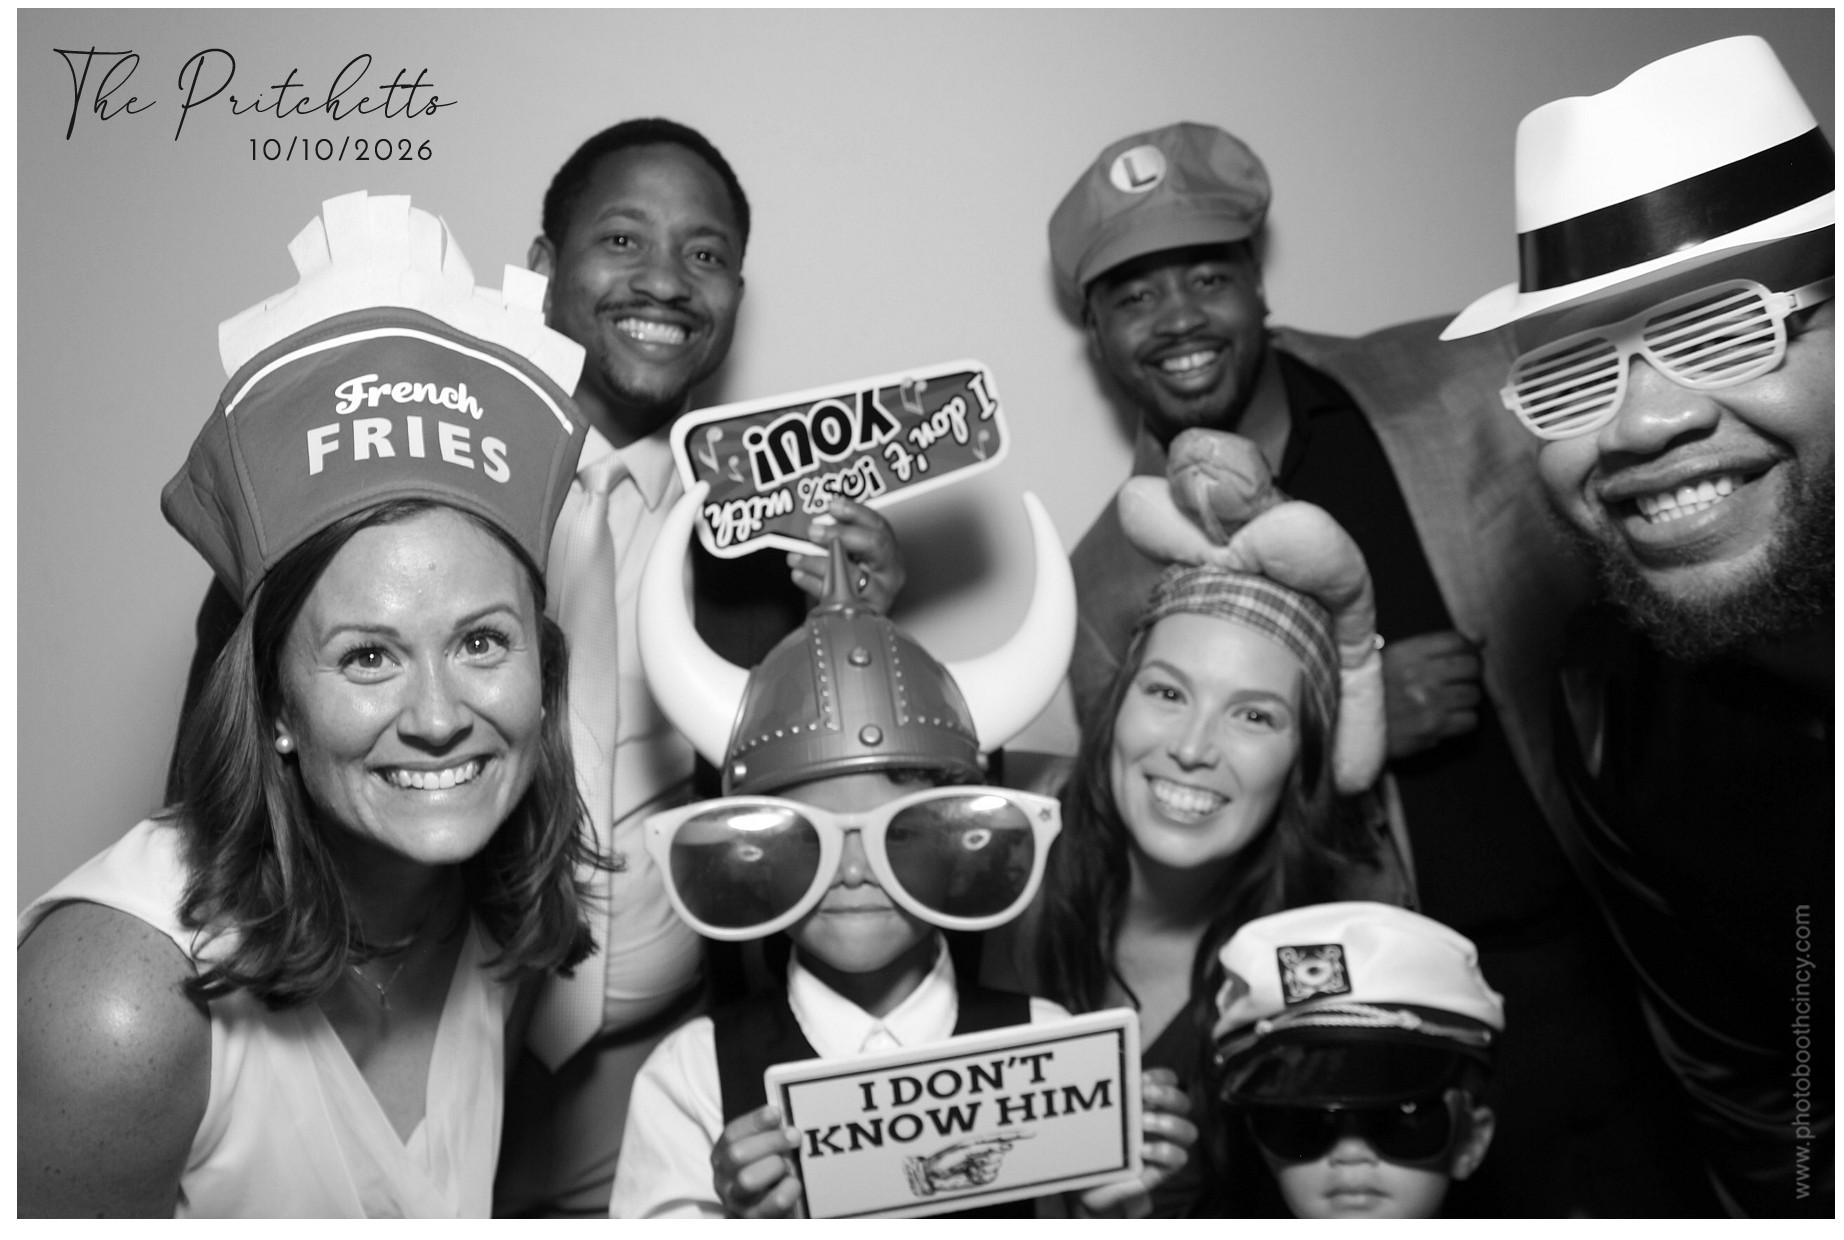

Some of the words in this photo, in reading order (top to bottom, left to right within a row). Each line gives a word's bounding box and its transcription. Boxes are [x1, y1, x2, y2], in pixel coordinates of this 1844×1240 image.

[1123, 157, 1157, 187] L
[334, 373, 483, 420] French
[968, 373, 996, 420] I
[306, 415, 511, 484] FRIES
[743, 388, 900, 488] YOU!
[884, 396, 968, 482] don't
[705, 489, 794, 547] with
[858, 1081, 879, 1113] I
[889, 1051, 1055, 1107] DON'T
[803, 1102, 983, 1159] KNOW
[996, 1079, 1114, 1126] HIM
